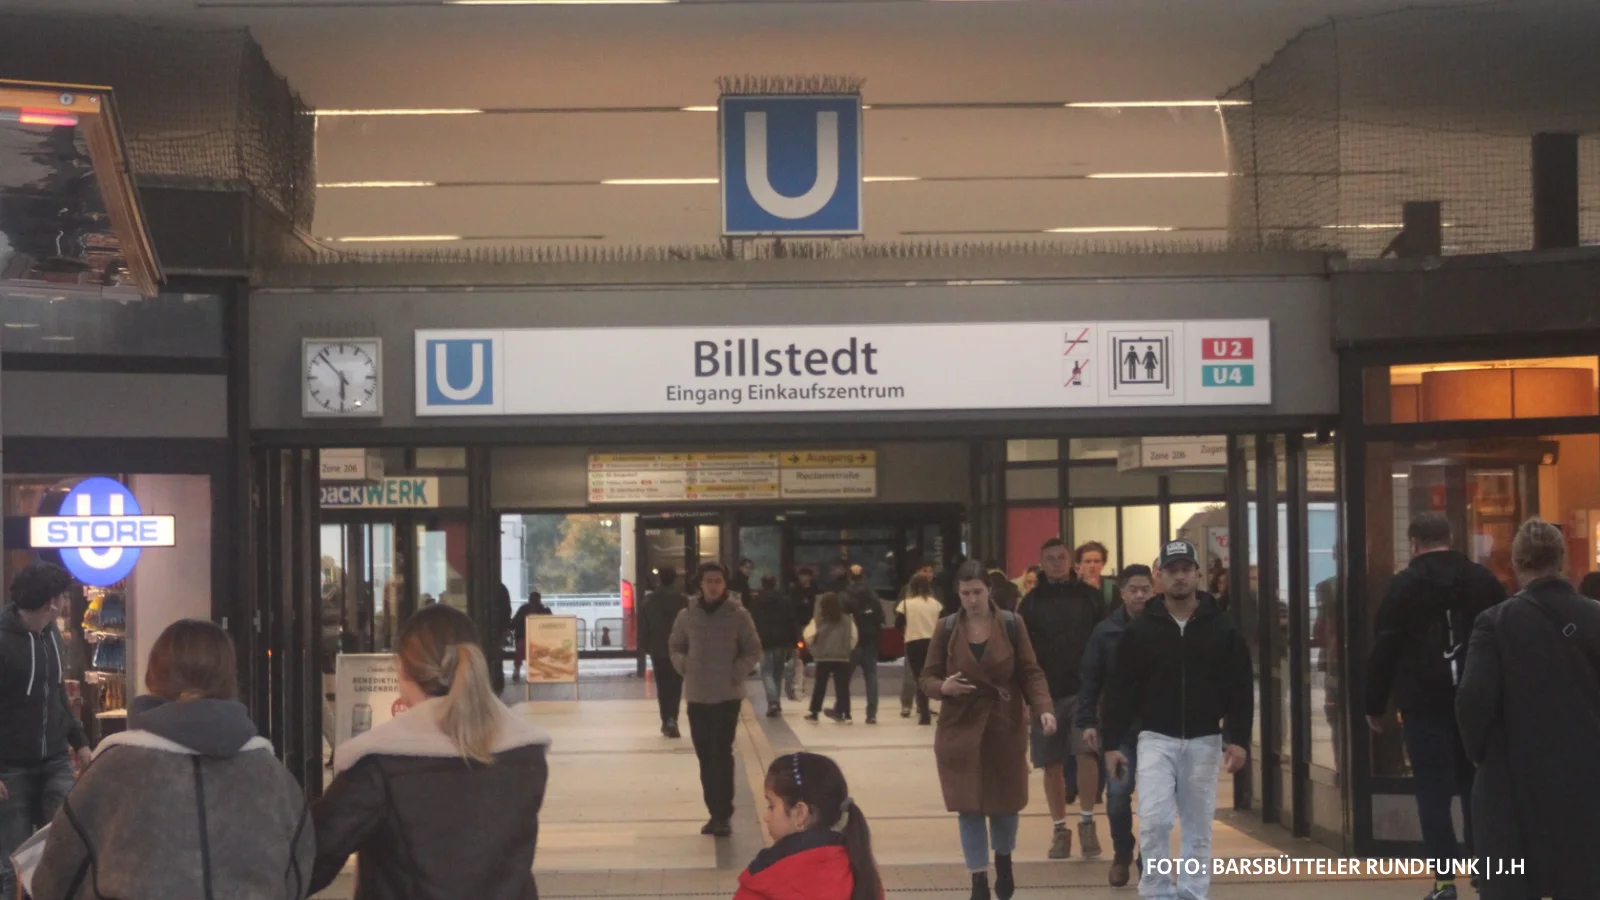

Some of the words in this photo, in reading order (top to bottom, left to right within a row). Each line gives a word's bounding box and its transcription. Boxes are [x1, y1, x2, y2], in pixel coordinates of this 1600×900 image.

[744, 111, 838, 219] U
[694, 337, 878, 378] Billstedt
[1213, 340, 1243, 357] U2
[435, 343, 484, 401] U
[1213, 367, 1243, 384] U4
[666, 385, 742, 405] Eingang
[748, 382, 905, 401] Einkaufszentrum
[1150, 451, 1169, 461] Zone
[322, 463, 341, 473] Zone
[344, 463, 358, 473] 206
[47, 520, 158, 543] STORE
